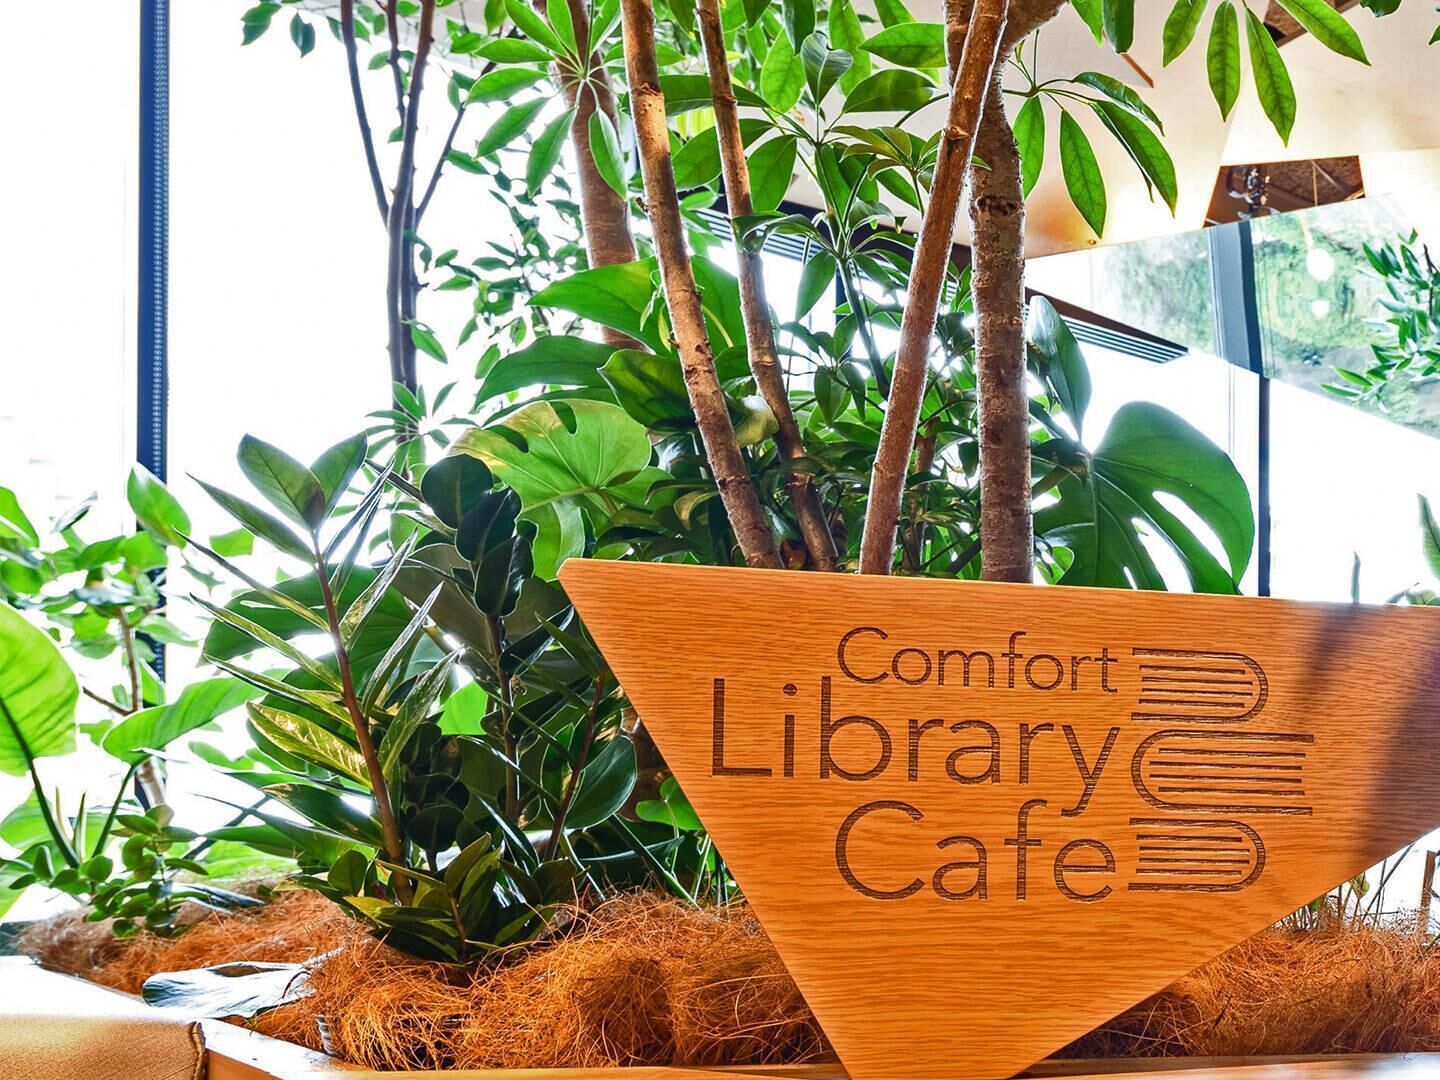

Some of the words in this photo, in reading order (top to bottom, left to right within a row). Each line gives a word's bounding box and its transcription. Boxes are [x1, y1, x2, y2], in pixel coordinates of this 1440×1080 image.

[837, 626, 1118, 694] Comfort
[711, 675, 1121, 818] Library
[835, 798, 1117, 903] Cafe
